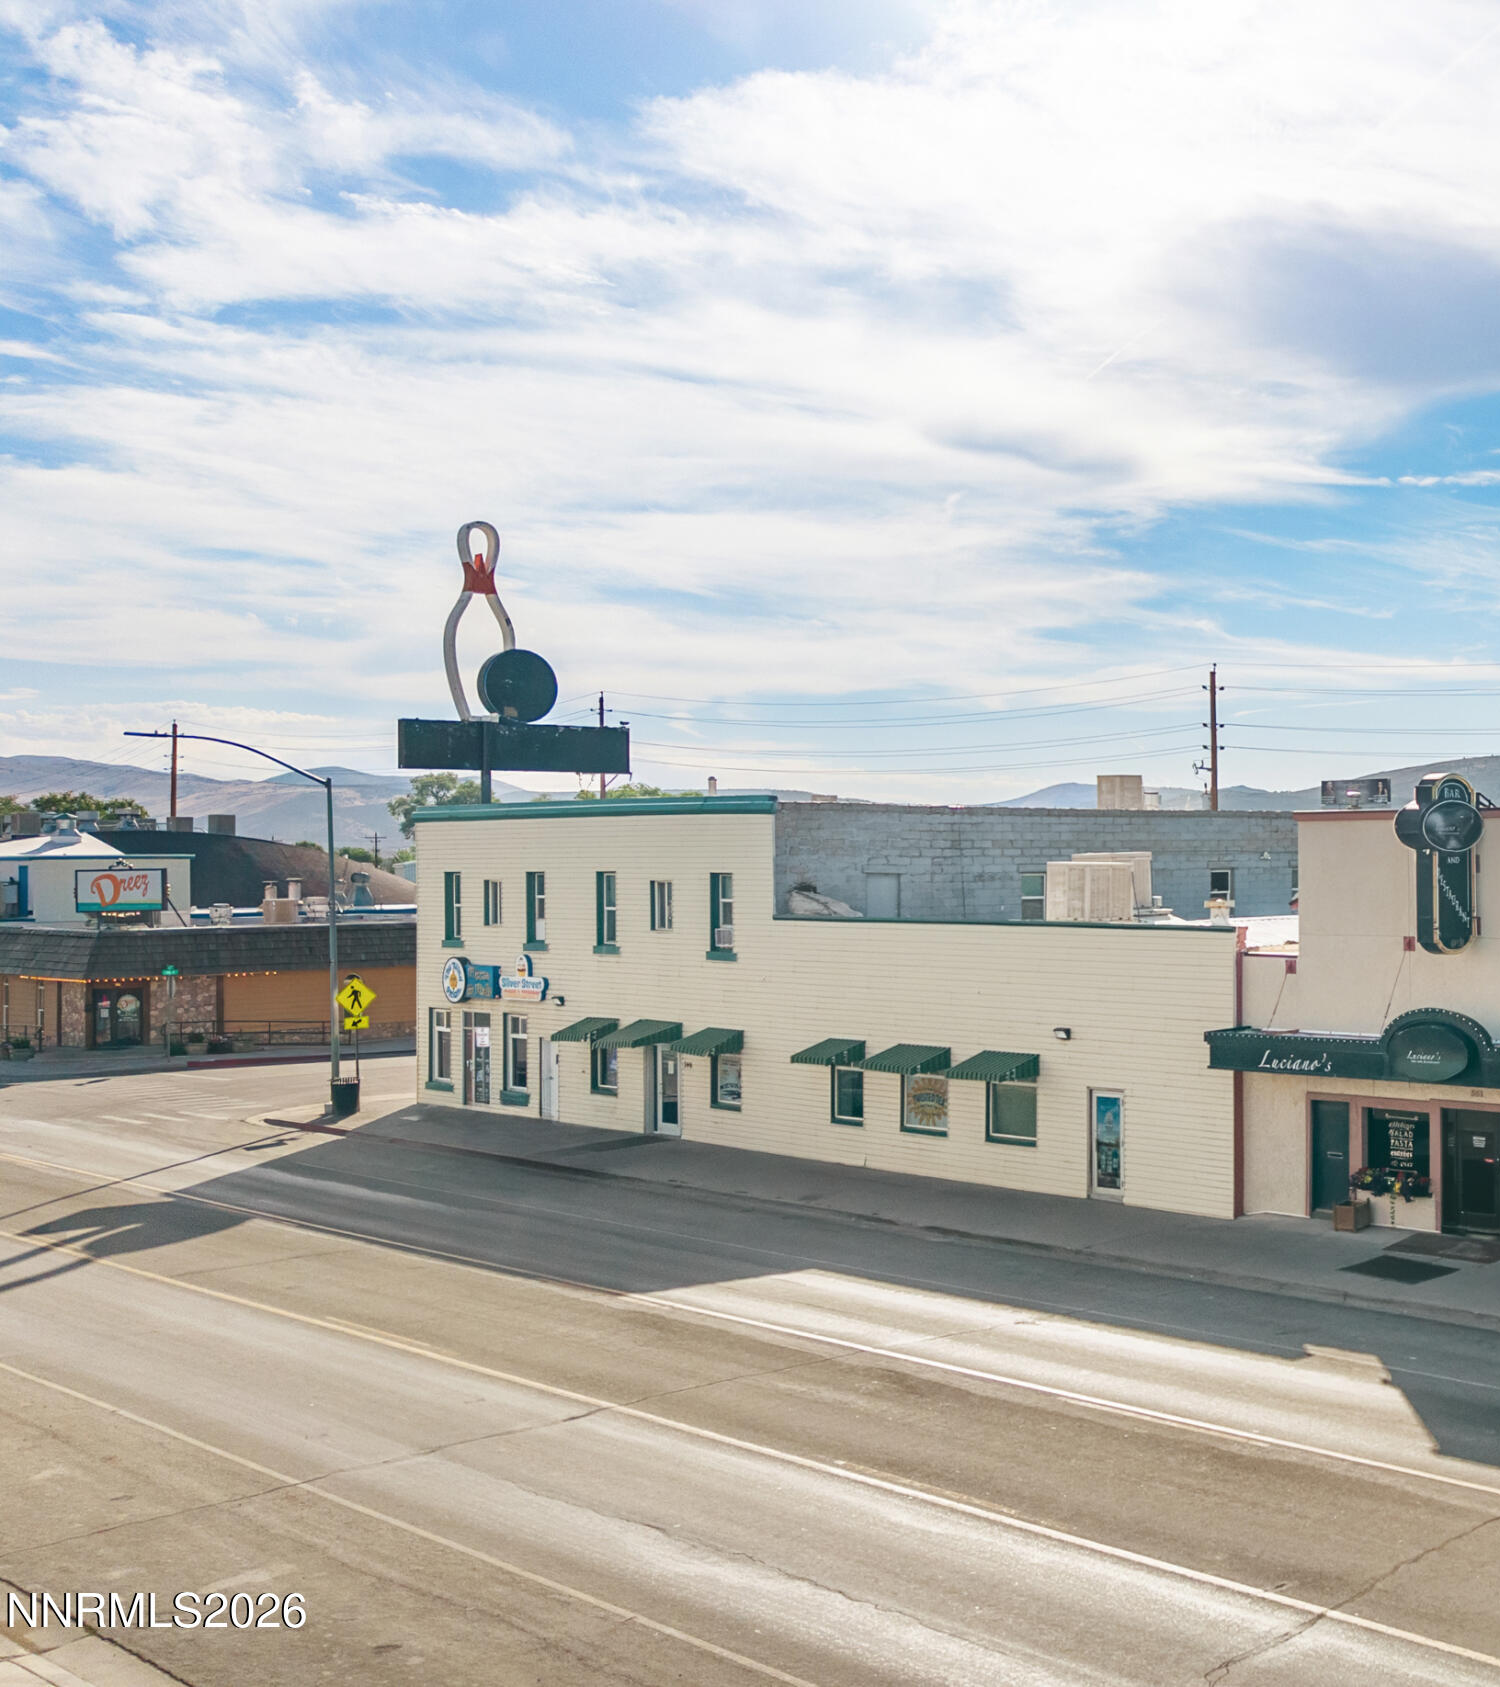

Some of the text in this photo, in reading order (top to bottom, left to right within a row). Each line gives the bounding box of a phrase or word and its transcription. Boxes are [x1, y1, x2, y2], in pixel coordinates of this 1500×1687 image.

[1444, 787, 1461, 799] BAR
[1447, 856, 1460, 865] AND
[501, 977, 520, 988] Silver
[1258, 1049, 1332, 1073] Luciano's
[1390, 1139, 1414, 1148] PASTA
